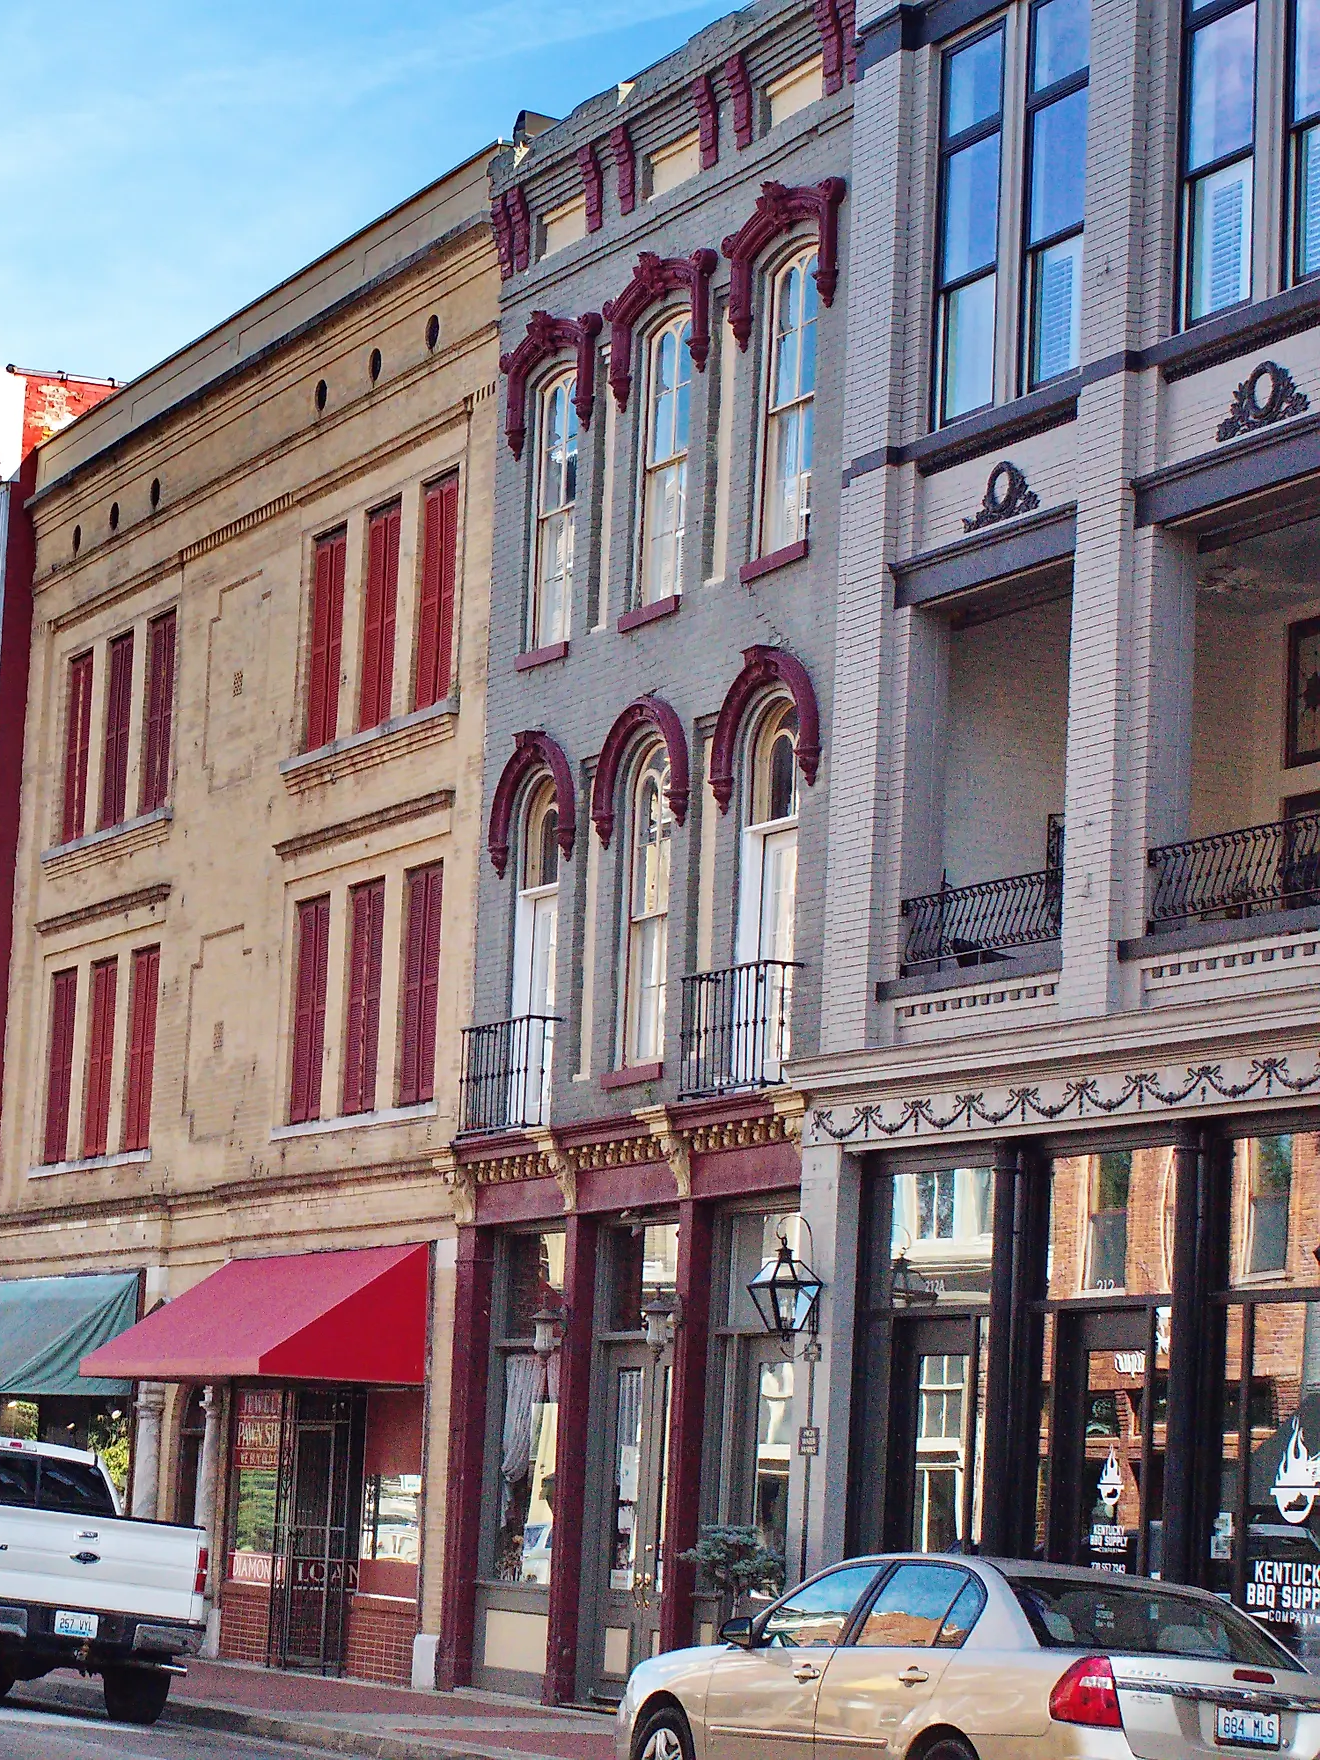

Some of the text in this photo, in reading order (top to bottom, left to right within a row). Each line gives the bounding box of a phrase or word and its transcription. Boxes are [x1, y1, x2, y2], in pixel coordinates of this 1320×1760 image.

[237, 1421, 263, 1447] PAWN
[1089, 1534, 1129, 1547] BBQ SUPPLY
[1093, 1524, 1125, 1536] KENTUCKY
[232, 1556, 282, 1581] DIAMONS
[1254, 1560, 1320, 1587] KENTUCK
[1246, 1582, 1320, 1610] BBQ SUPP
[60, 1617, 74, 1629] 257
[1268, 1609, 1315, 1625] COMPANY
[1223, 1716, 1274, 1738] 884 MLS
